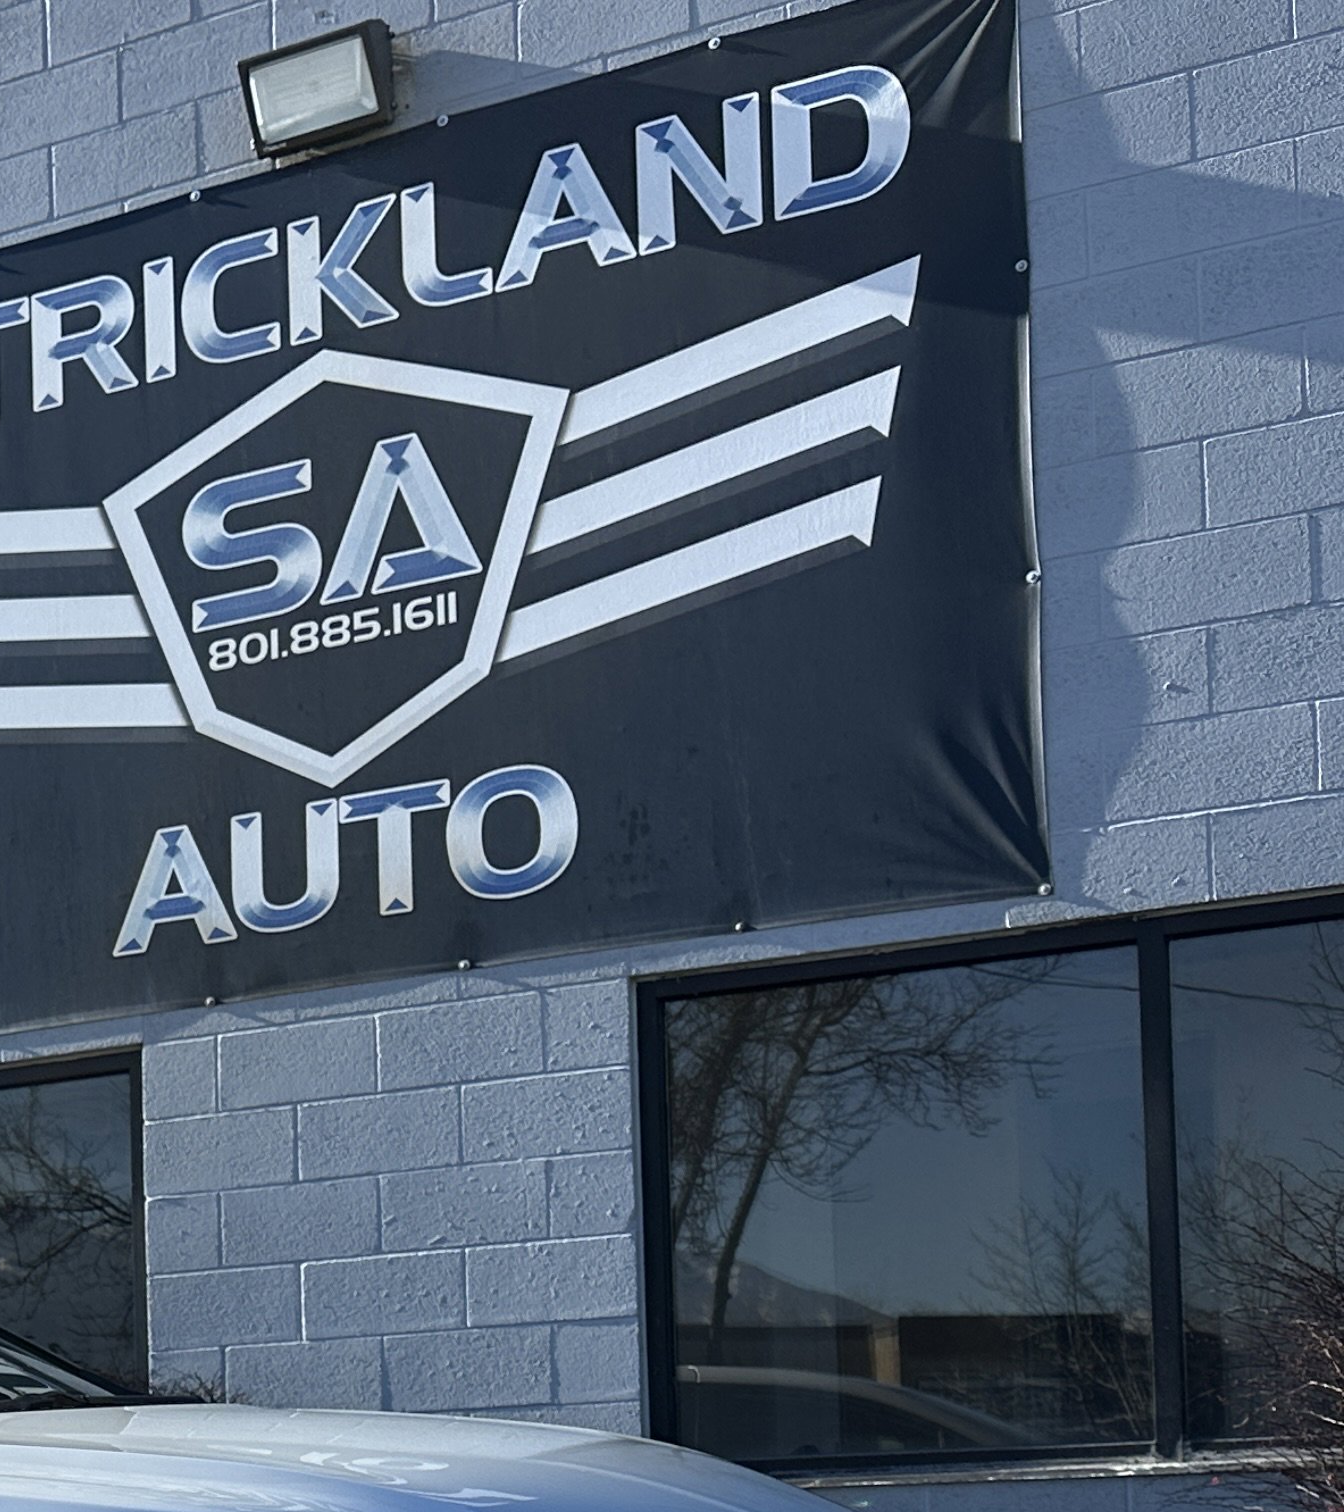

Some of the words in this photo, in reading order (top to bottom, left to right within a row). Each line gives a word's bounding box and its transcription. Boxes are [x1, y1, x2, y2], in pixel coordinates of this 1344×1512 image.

[182, 432, 483, 633] SA
[208, 590, 459, 672] 801.885.1611
[112, 764, 579, 958] AUTO
